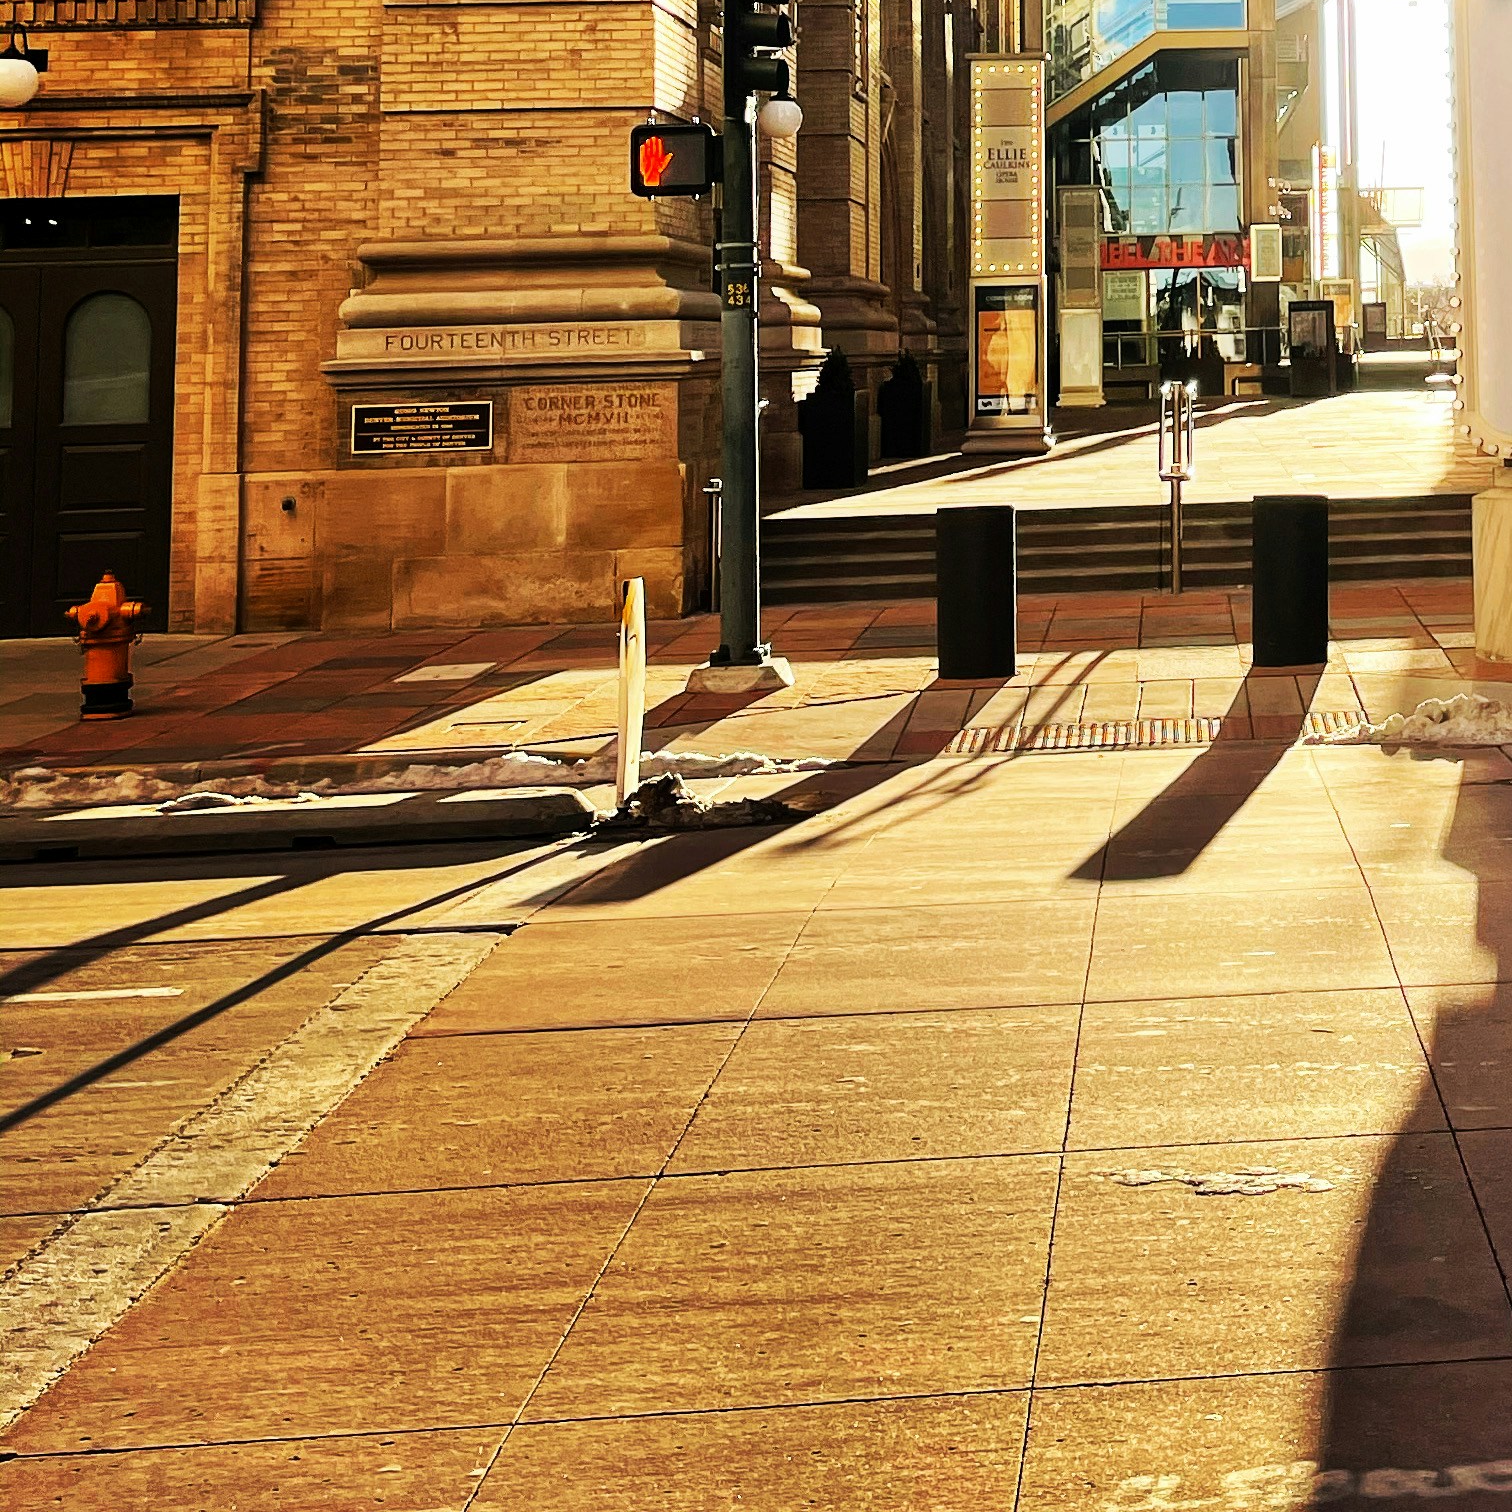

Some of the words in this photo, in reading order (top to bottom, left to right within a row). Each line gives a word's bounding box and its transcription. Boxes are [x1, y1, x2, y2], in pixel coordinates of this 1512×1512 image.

[987, 148, 1027, 160] ELLIE
[384, 329, 536, 352] FOURTEENTH
[548, 327, 635, 347] STREET
[525, 395, 596, 411] CORNER
